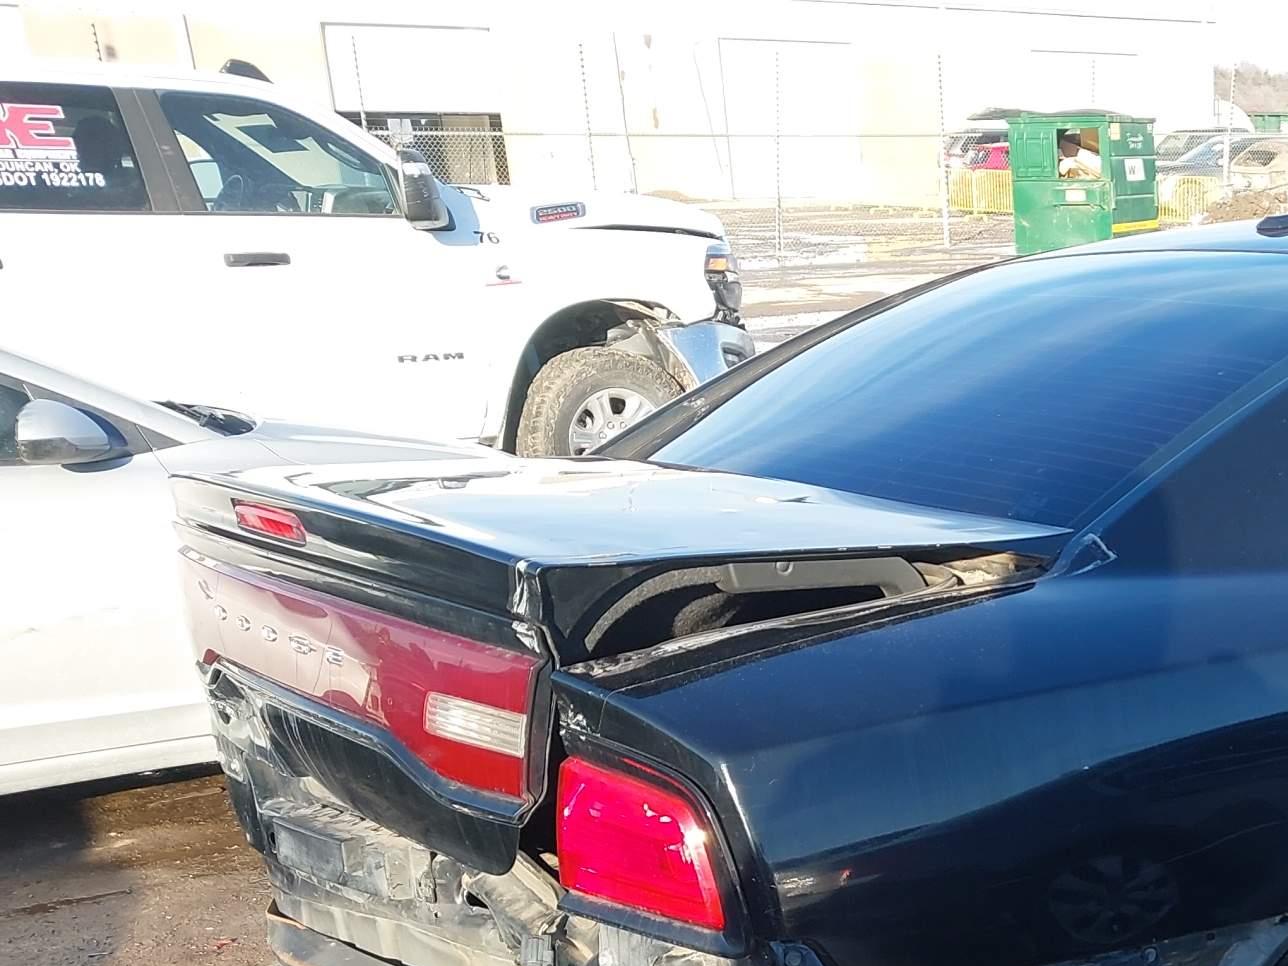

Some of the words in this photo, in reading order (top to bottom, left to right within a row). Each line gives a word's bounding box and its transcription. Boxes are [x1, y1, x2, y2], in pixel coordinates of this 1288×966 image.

[60, 162, 81, 172] OK
[0, 172, 36, 186] DOT
[41, 172, 106, 187] 1922178
[473, 231, 500, 245] 76
[397, 352, 465, 364] RAM
